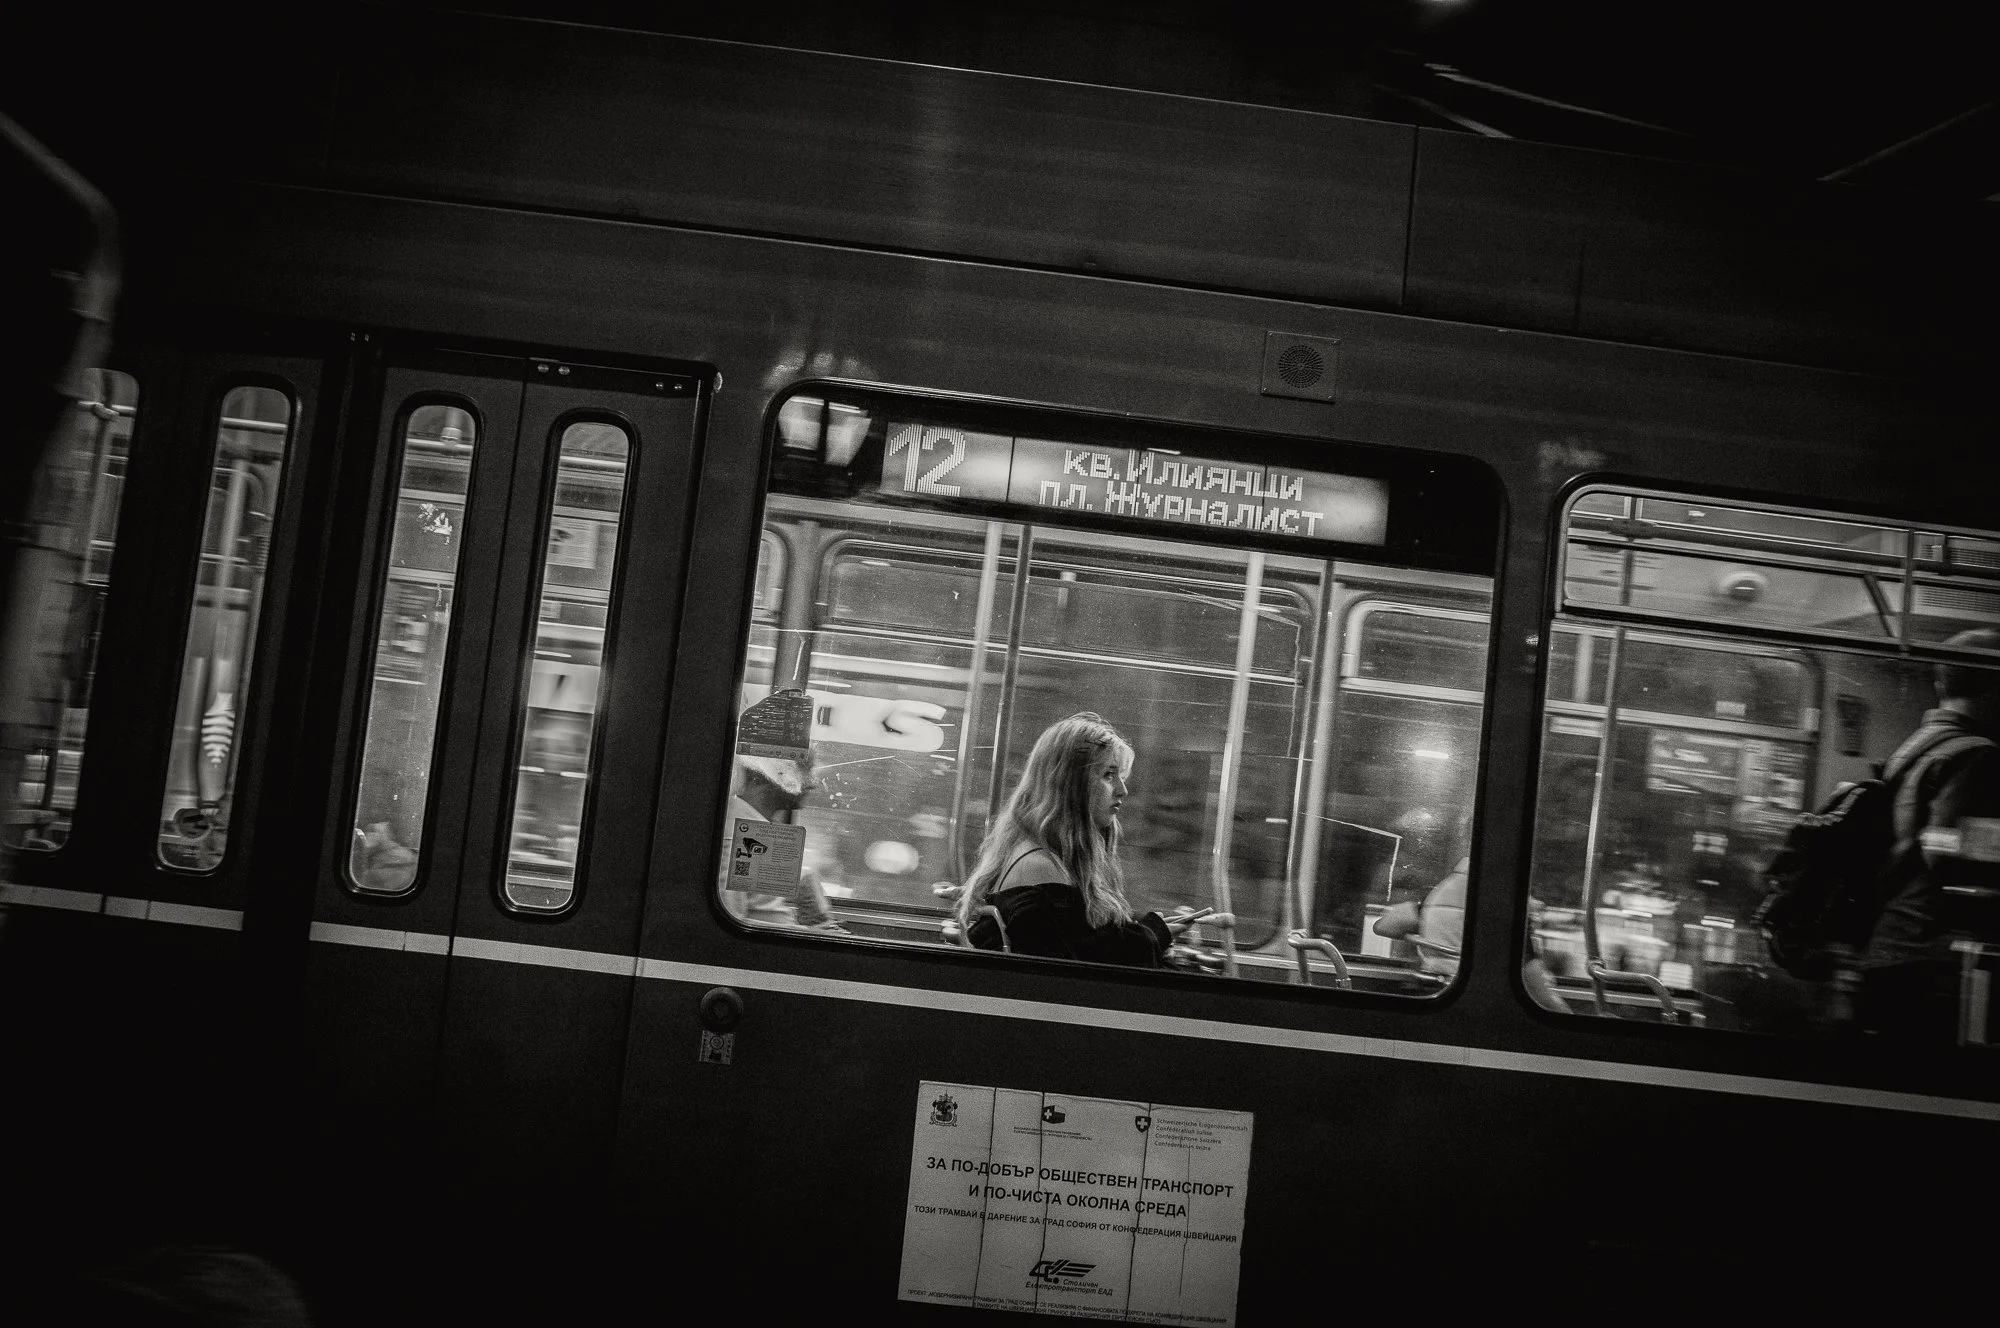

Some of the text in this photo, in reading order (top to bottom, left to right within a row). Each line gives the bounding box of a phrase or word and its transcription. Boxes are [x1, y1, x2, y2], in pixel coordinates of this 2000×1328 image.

[889, 424, 966, 497] 12
[926, 1156, 1234, 1198] ЗА ПО-ДОБЪР ОБЩЕСТВЕН ТРАНСПОРТ
[968, 1184, 1187, 1218] И ПО-ЧИСТА ОКОЛНА СРЕДА
[914, 1205, 936, 1214] ТОЗИ
[938, 1207, 977, 1218] ТРАМВАЙ
[987, 1212, 1027, 1223] ДАРЕНИЕ
[1029, 1216, 1041, 1225] ЗА
[1042, 1217, 1065, 1228] ГРАД
[1066, 1220, 1097, 1230] СОФИЯ
[1099, 1223, 1111, 1231] ОТ
[1112, 1224, 1182, 1238] КОНФЕДЕРАЦИЯ
[1183, 1231, 1237, 1243] ШВЕЙЦАРИЯ
[1097, 1287, 1114, 1297] ЕАД
